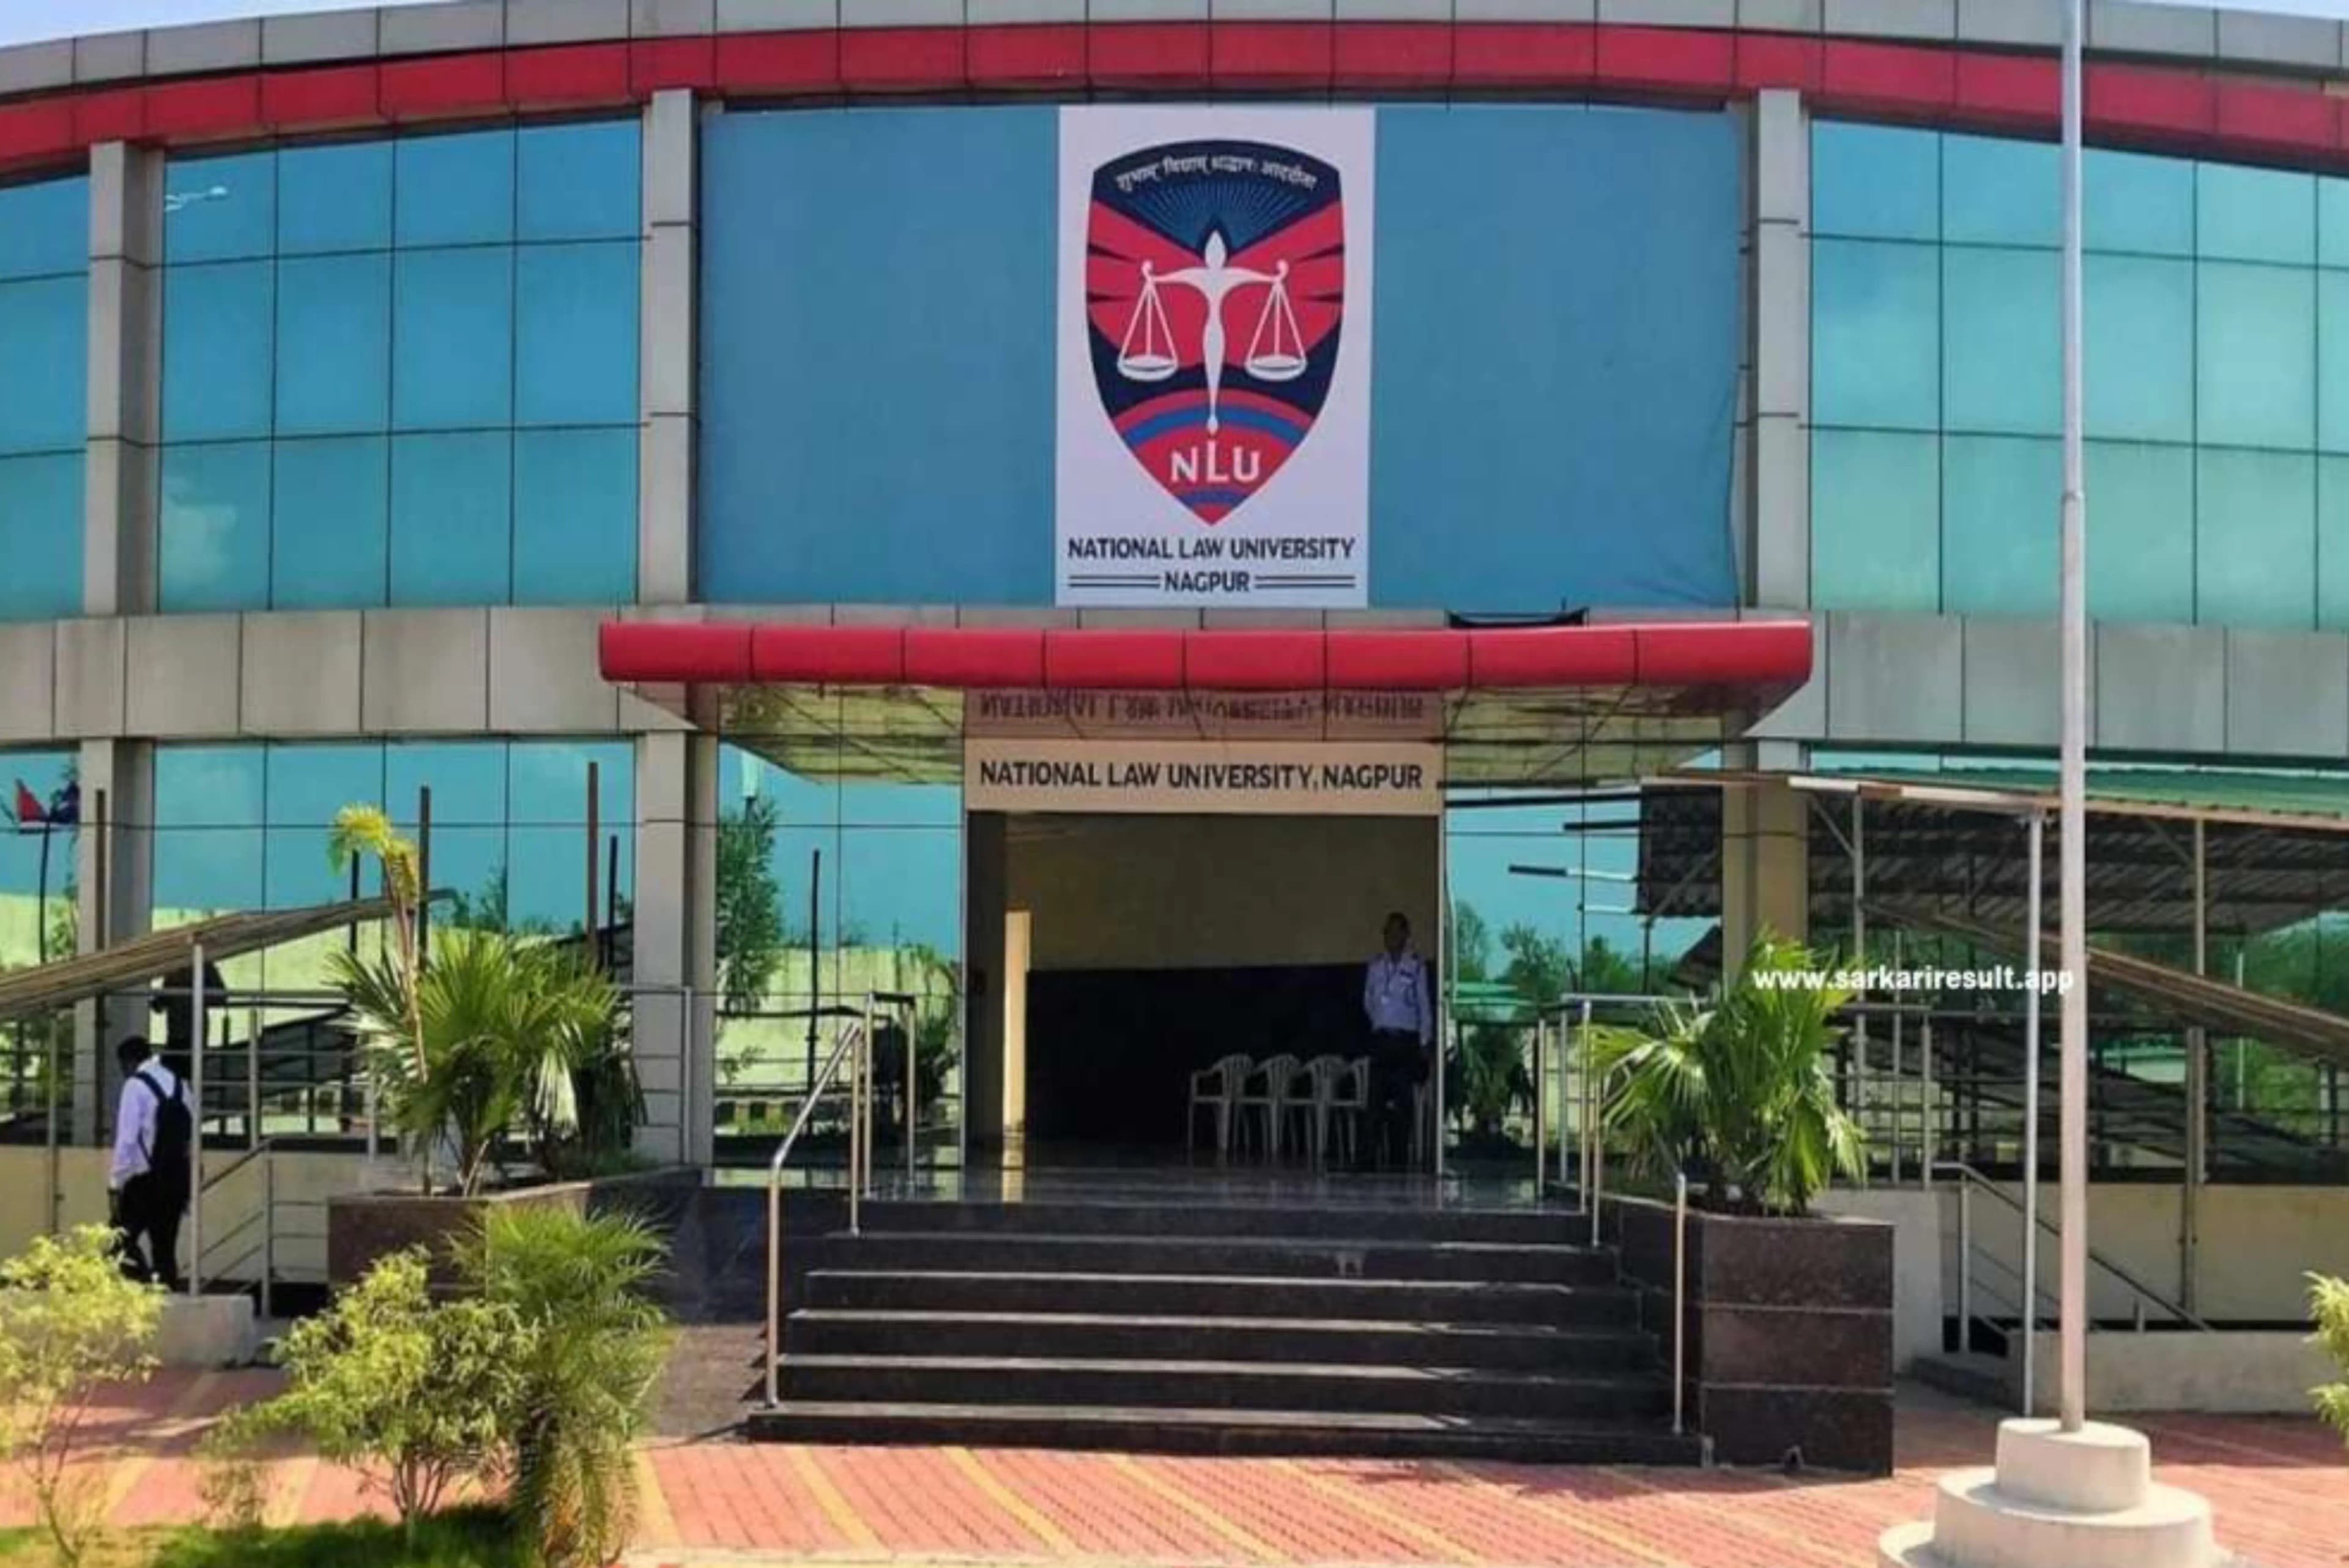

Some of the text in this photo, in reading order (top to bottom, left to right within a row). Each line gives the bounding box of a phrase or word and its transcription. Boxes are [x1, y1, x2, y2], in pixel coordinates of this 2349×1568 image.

[1170, 439, 1261, 483] NLU
[1068, 537, 1356, 560] NATIONAL LAW UNIVERSITY
[1164, 571, 1250, 592] NAGPUR
[980, 762, 1101, 786] NATIONAL
[1108, 762, 1161, 786] LAW
[1323, 764, 1423, 789] NAGPUR
